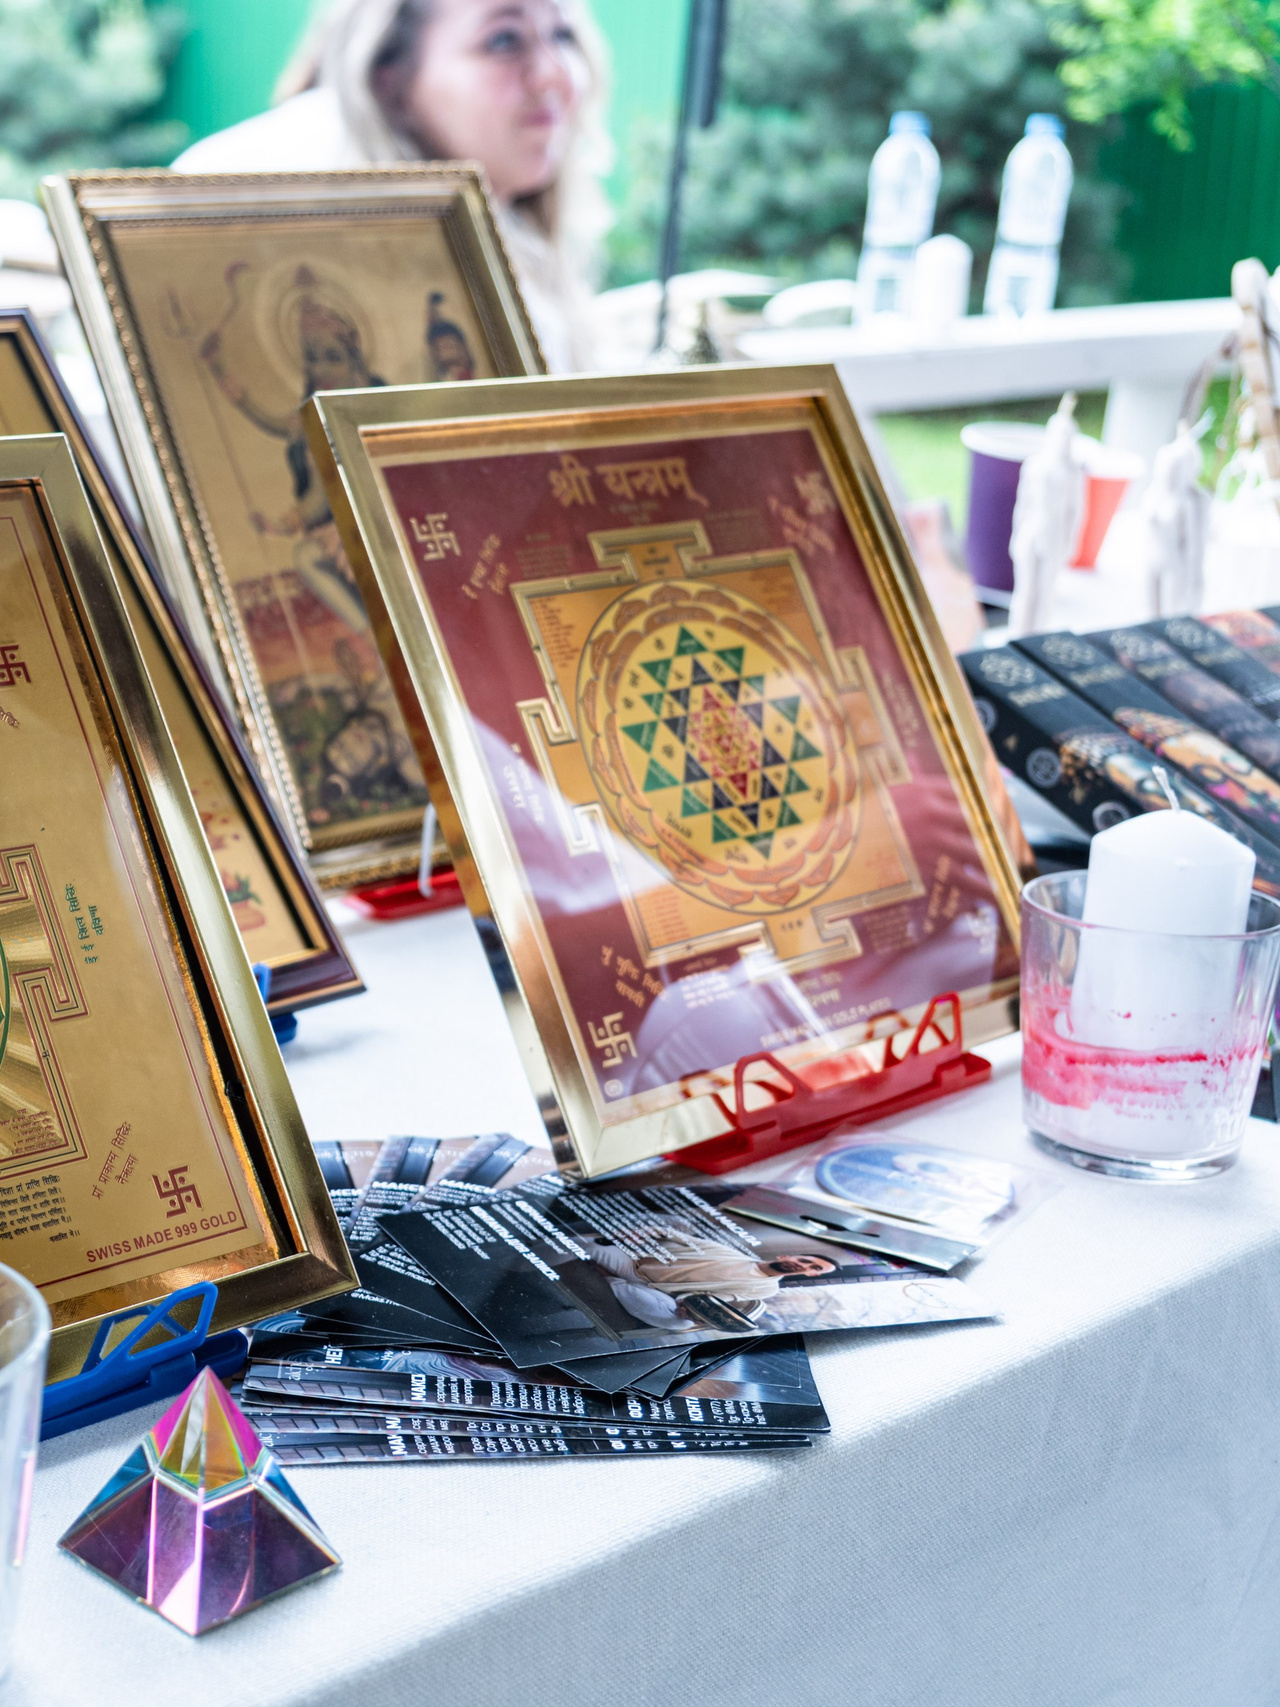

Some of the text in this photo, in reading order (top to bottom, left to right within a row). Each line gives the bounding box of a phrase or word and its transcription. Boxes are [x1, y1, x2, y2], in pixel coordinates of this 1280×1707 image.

[86, 1211, 238, 1263] SWISS MADE 999 GOLD
